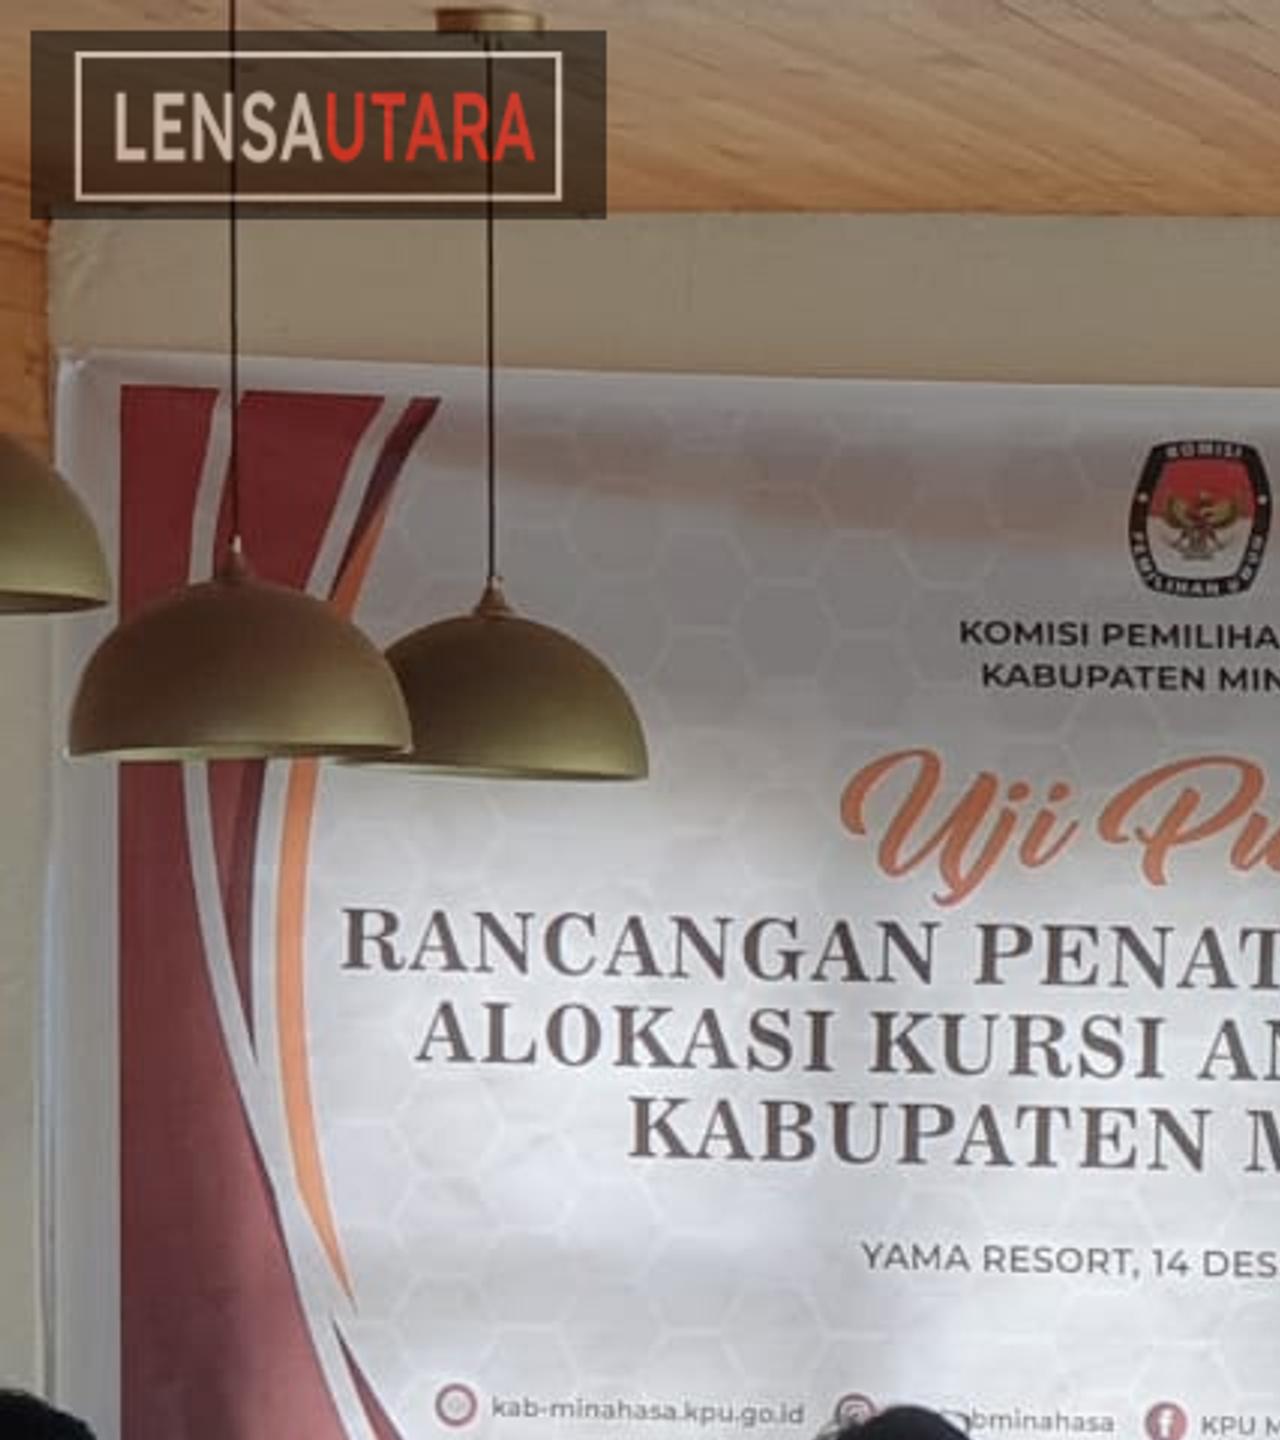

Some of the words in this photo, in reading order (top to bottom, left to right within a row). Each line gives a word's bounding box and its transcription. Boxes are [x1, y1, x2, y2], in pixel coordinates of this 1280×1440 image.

[960, 620, 1089, 646] KOMISI
[981, 663, 1206, 692] KABUPATEN
[839, 748, 1078, 907] Uji
[341, 908, 943, 984] RANCANGAN
[414, 1001, 836, 1072] ALOKASI
[867, 1010, 1166, 1079] KURSI
[628, 1096, 1210, 1173] KABUPATEN
[861, 1241, 969, 1273] YAMA
[983, 1244, 1140, 1281] RESORT,
[1153, 1249, 1190, 1277] 14
[491, 1397, 804, 1428] kab-minahasa.kpu.go.id
[1201, 1413, 1256, 1437] KPU
